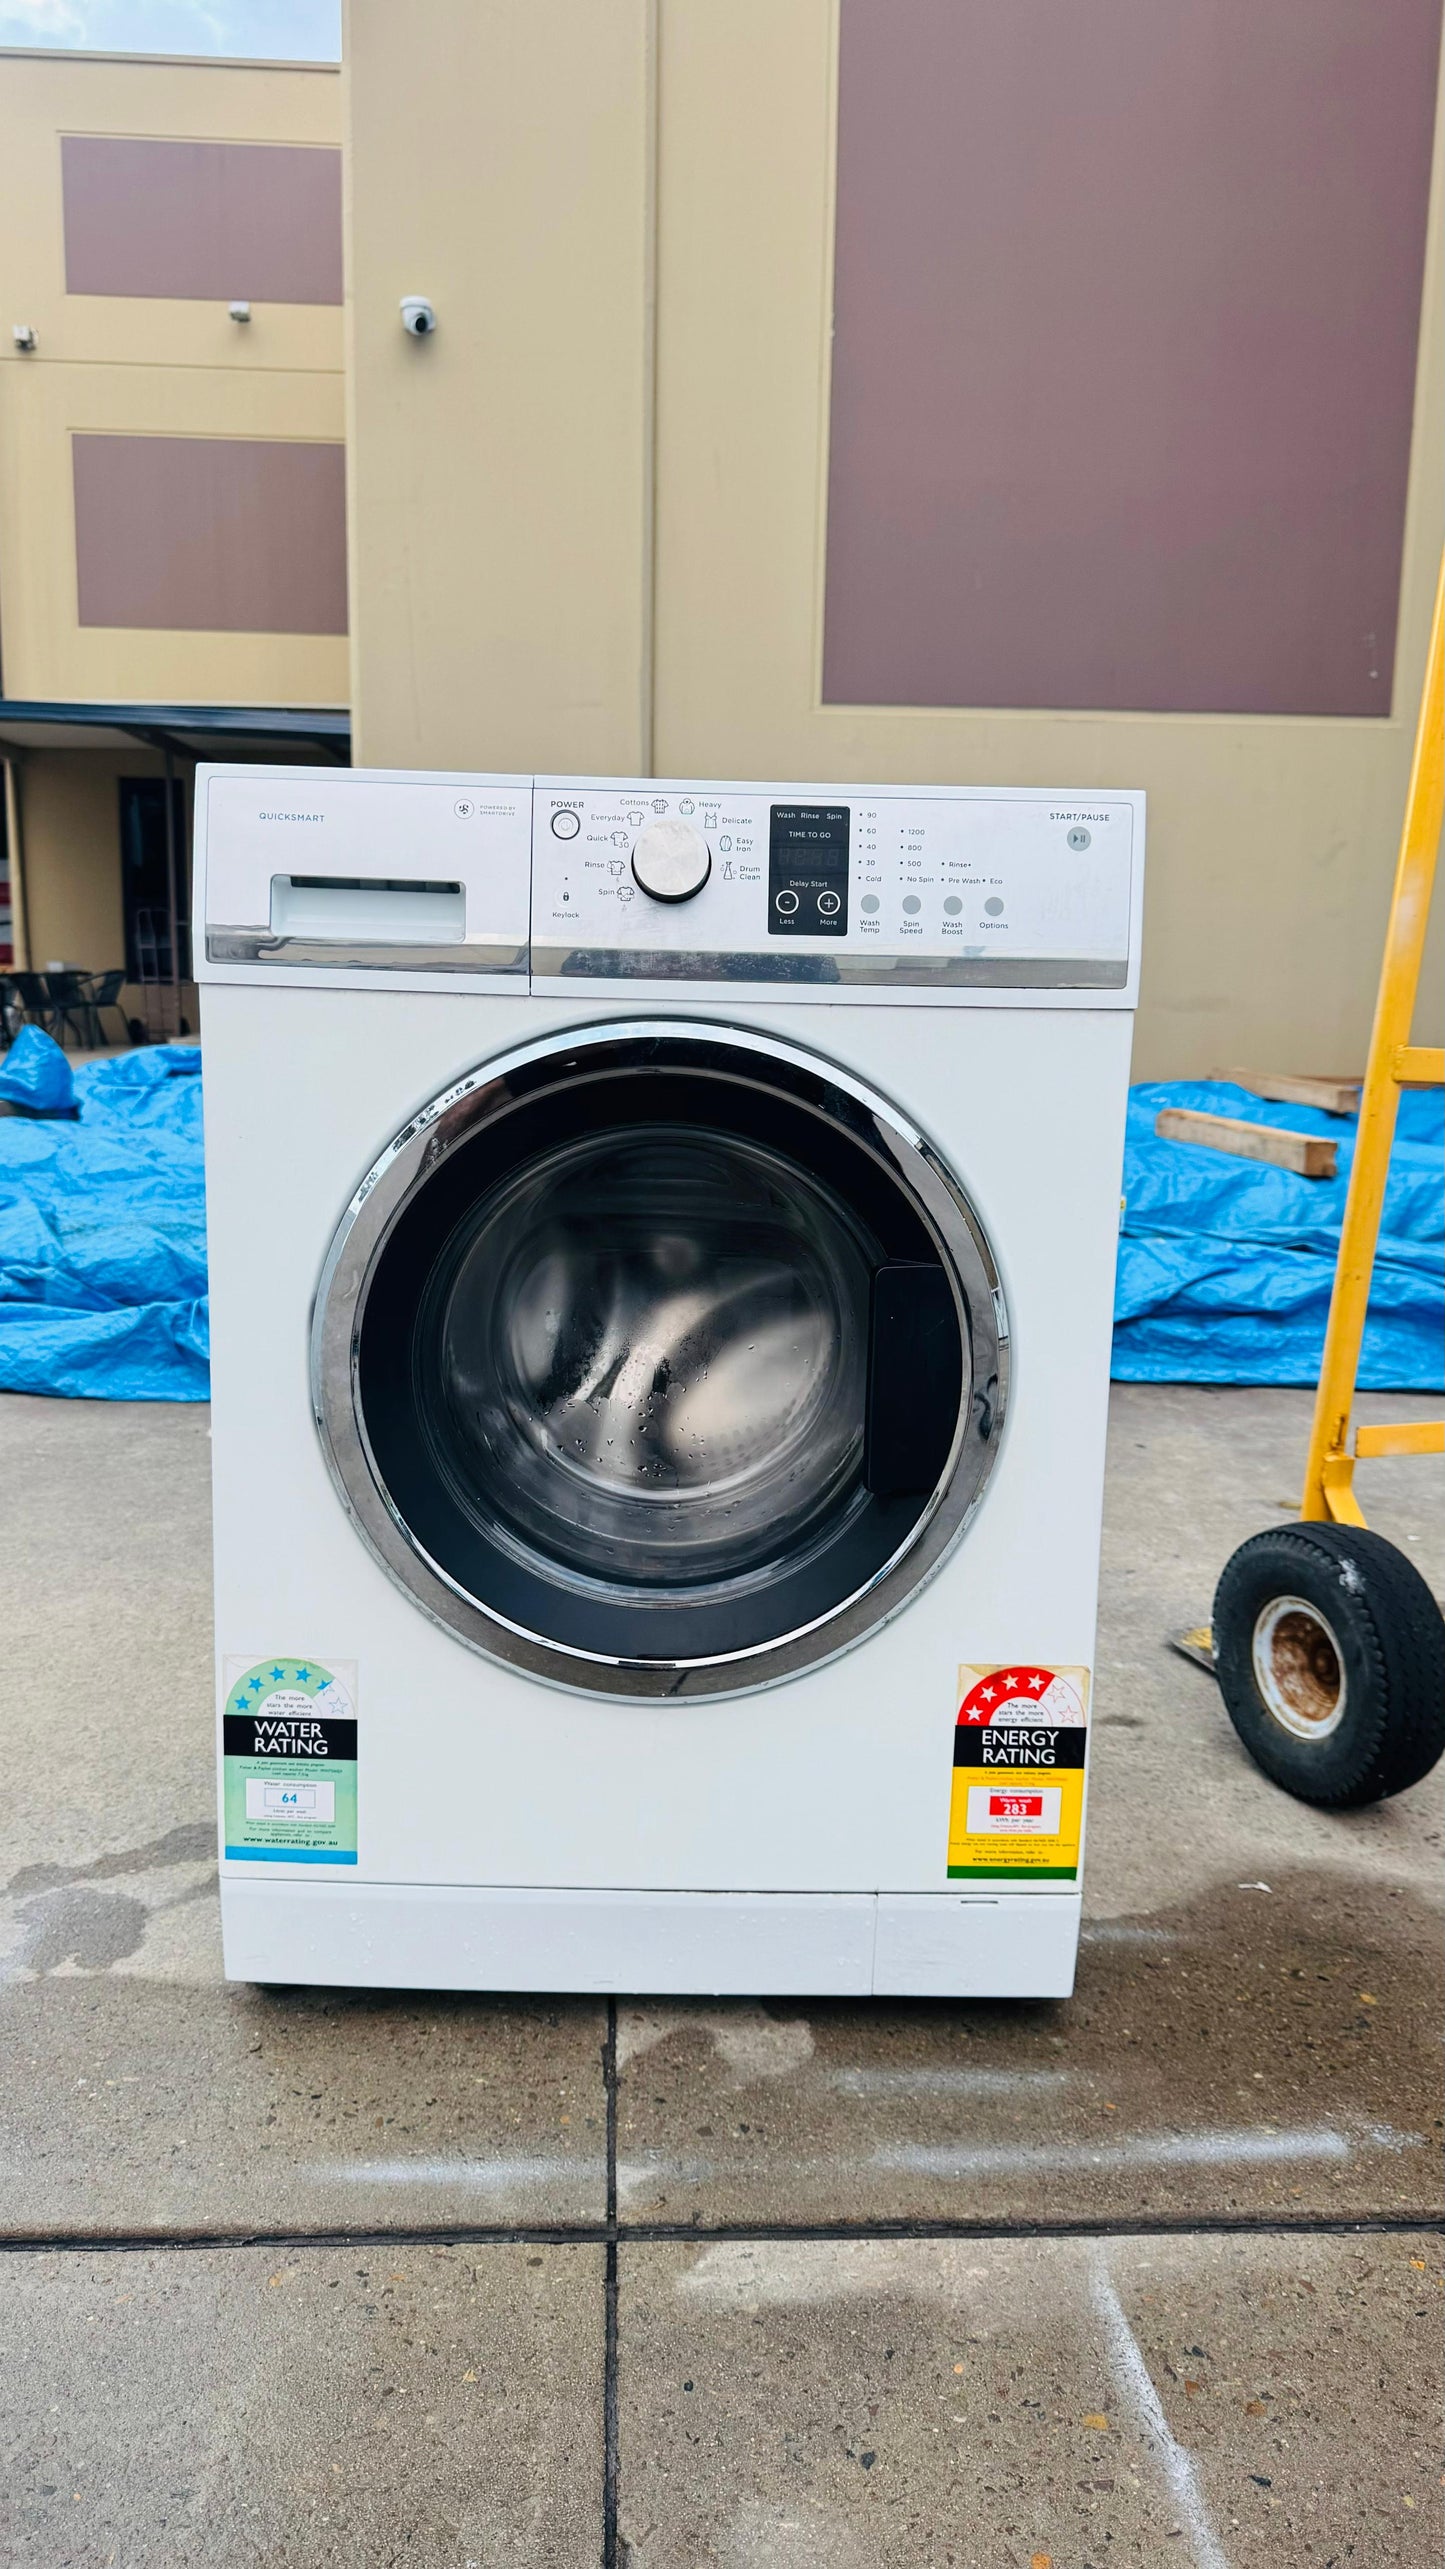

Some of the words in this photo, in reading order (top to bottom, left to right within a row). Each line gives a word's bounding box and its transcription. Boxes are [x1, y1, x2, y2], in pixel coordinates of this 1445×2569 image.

[550, 801, 584, 809] POWER
[699, 801, 722, 809] Heavy
[258, 812, 325, 823] QUICKSMART
[591, 814, 625, 822] Everyday
[800, 812, 820, 820] Rinse
[826, 812, 842, 821] Spin
[1049, 812, 1110, 822] START/PAUSE
[586, 834, 608, 842] Quick
[819, 831, 831, 839] GO
[736, 838, 754, 846] Easy
[584, 861, 605, 869] Rinse
[789, 880, 809, 888] Delay
[810, 880, 828, 888] Start
[918, 876, 934, 884] Spin
[598, 888, 615, 896] Spin
[552, 911, 580, 919] Keylock
[903, 920, 920, 928] Spin
[979, 922, 1009, 930] Options
[860, 926, 880, 934] Temp
[899, 927, 923, 935] Speed
[254, 1720, 323, 1738] WATER
[981, 1729, 1060, 1746] ENERGY
[254, 1737, 329, 1755] RATING
[982, 1748, 1056, 1765] RATING
[281, 1793, 297, 1804] 64
[1003, 1803, 1027, 1815] 283
